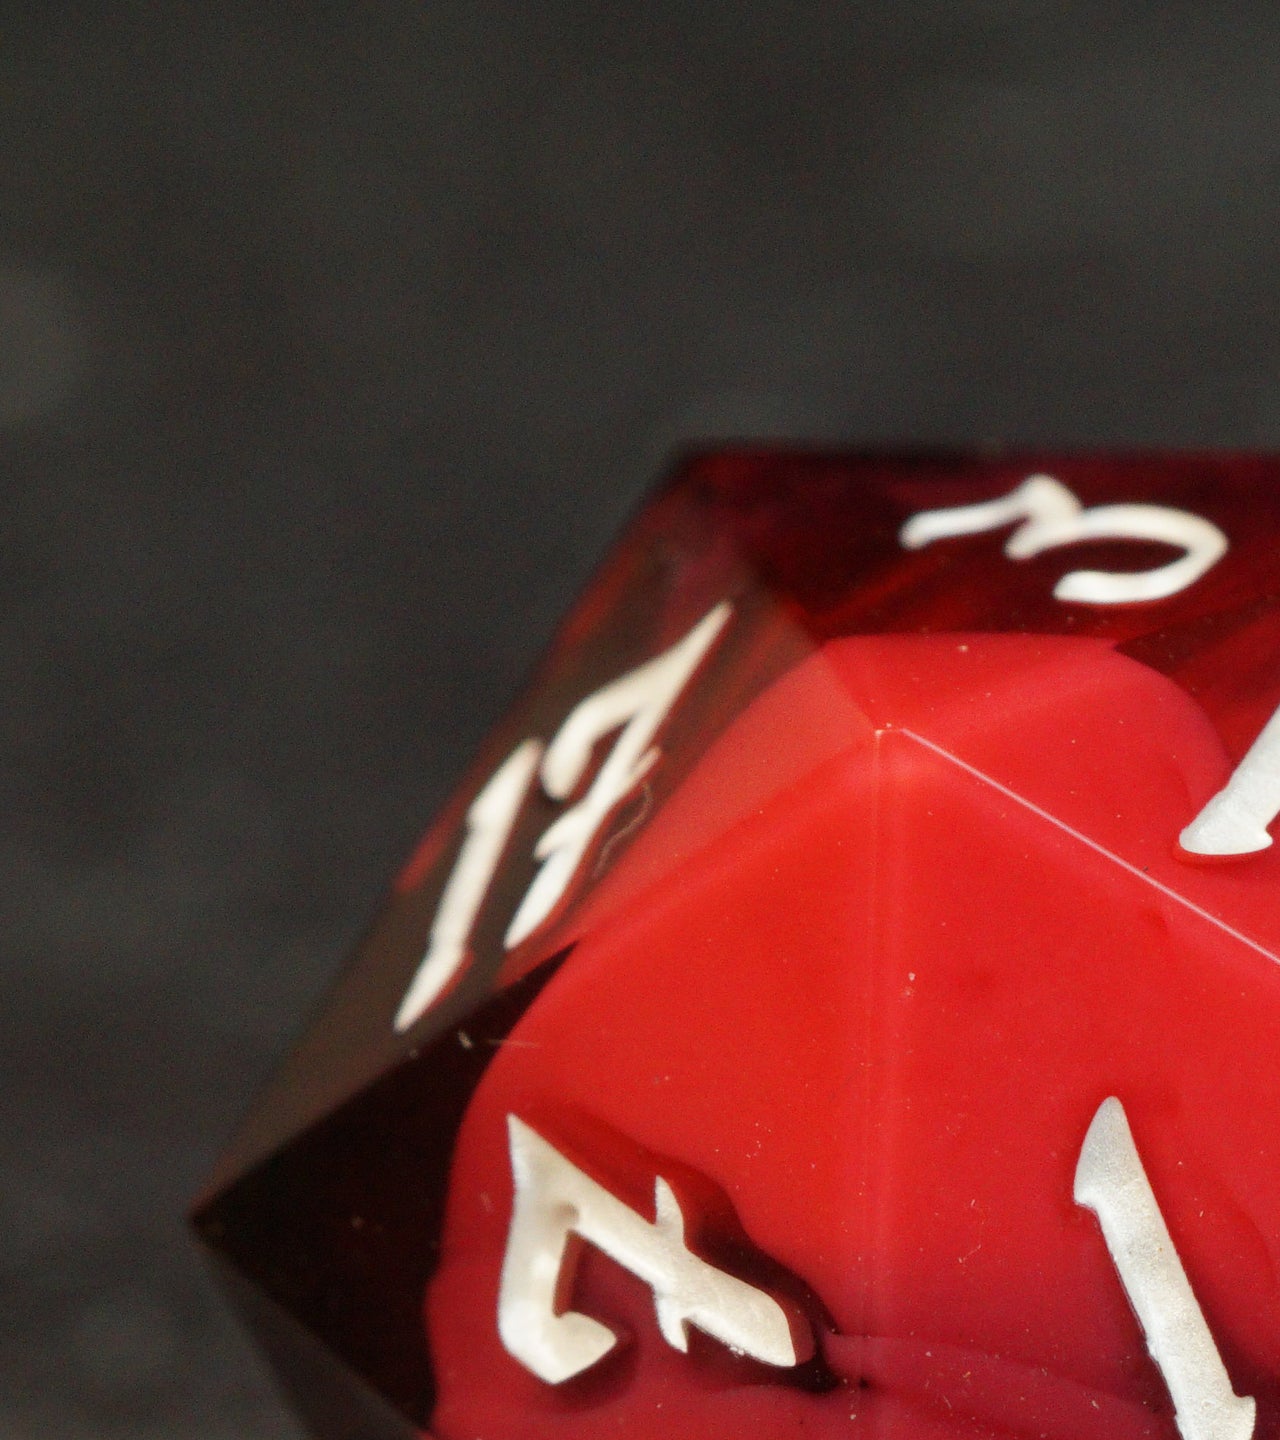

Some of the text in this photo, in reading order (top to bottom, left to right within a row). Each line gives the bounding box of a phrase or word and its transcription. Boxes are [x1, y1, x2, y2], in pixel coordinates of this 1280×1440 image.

[900, 474, 1229, 604] 3
[393, 603, 733, 1032] 17
[496, 1113, 797, 1386] 7
